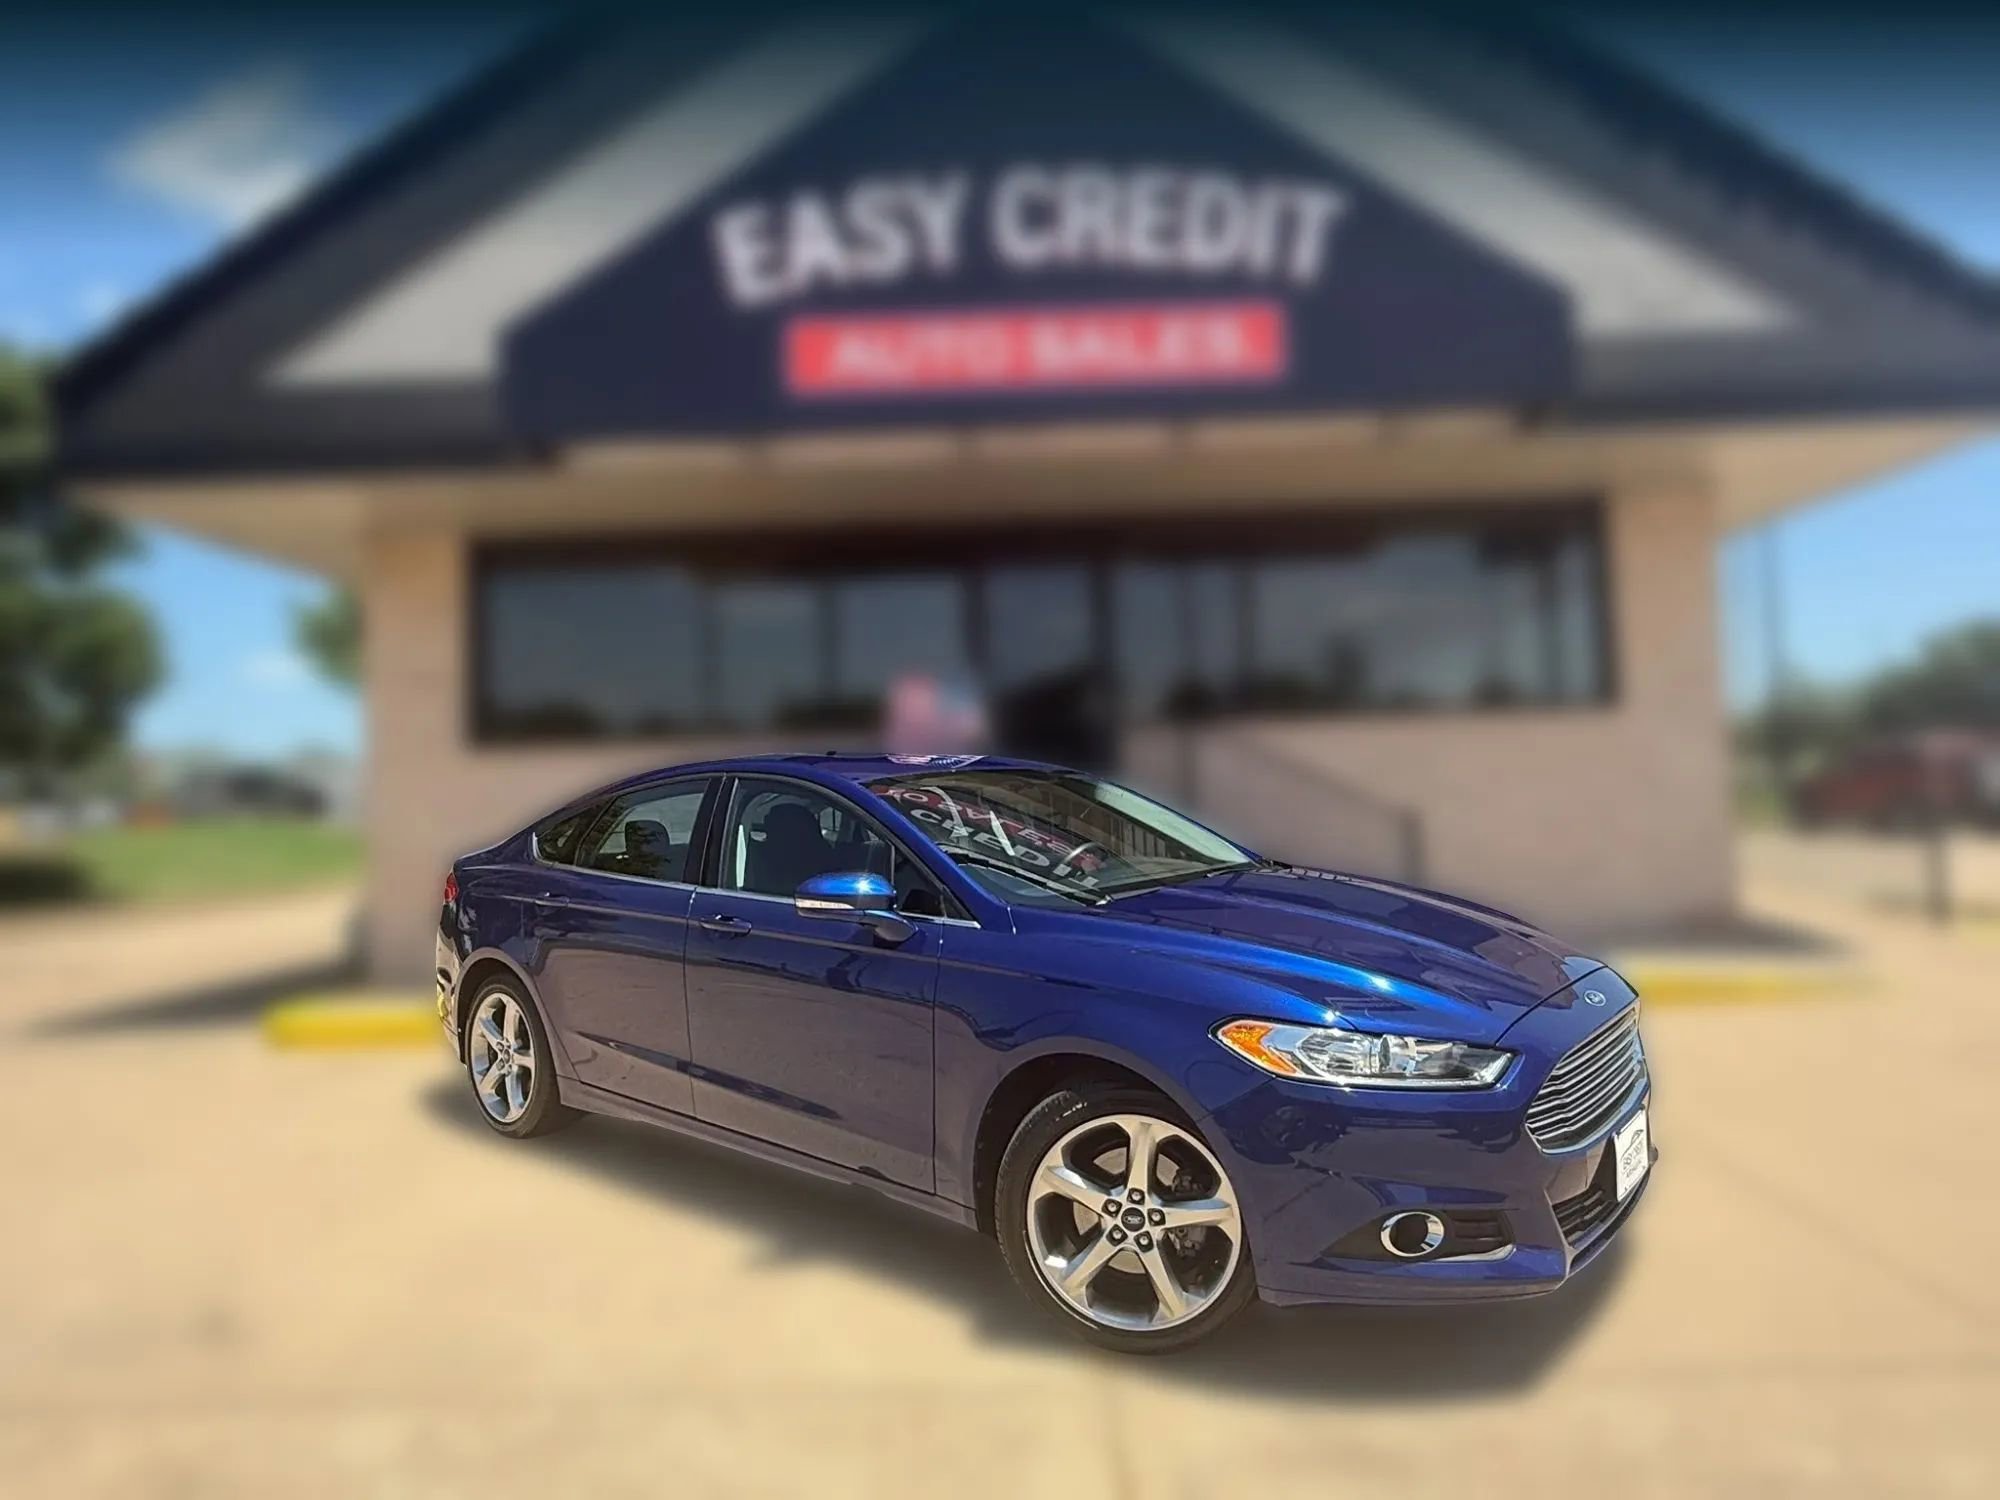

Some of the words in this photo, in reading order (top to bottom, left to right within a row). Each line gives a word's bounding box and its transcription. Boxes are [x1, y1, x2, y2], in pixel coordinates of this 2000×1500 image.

[715, 172, 968, 305] EASY
[993, 163, 1346, 284] CREDIT
[828, 324, 1010, 386] AUTO
[1028, 314, 1248, 379] SALES
